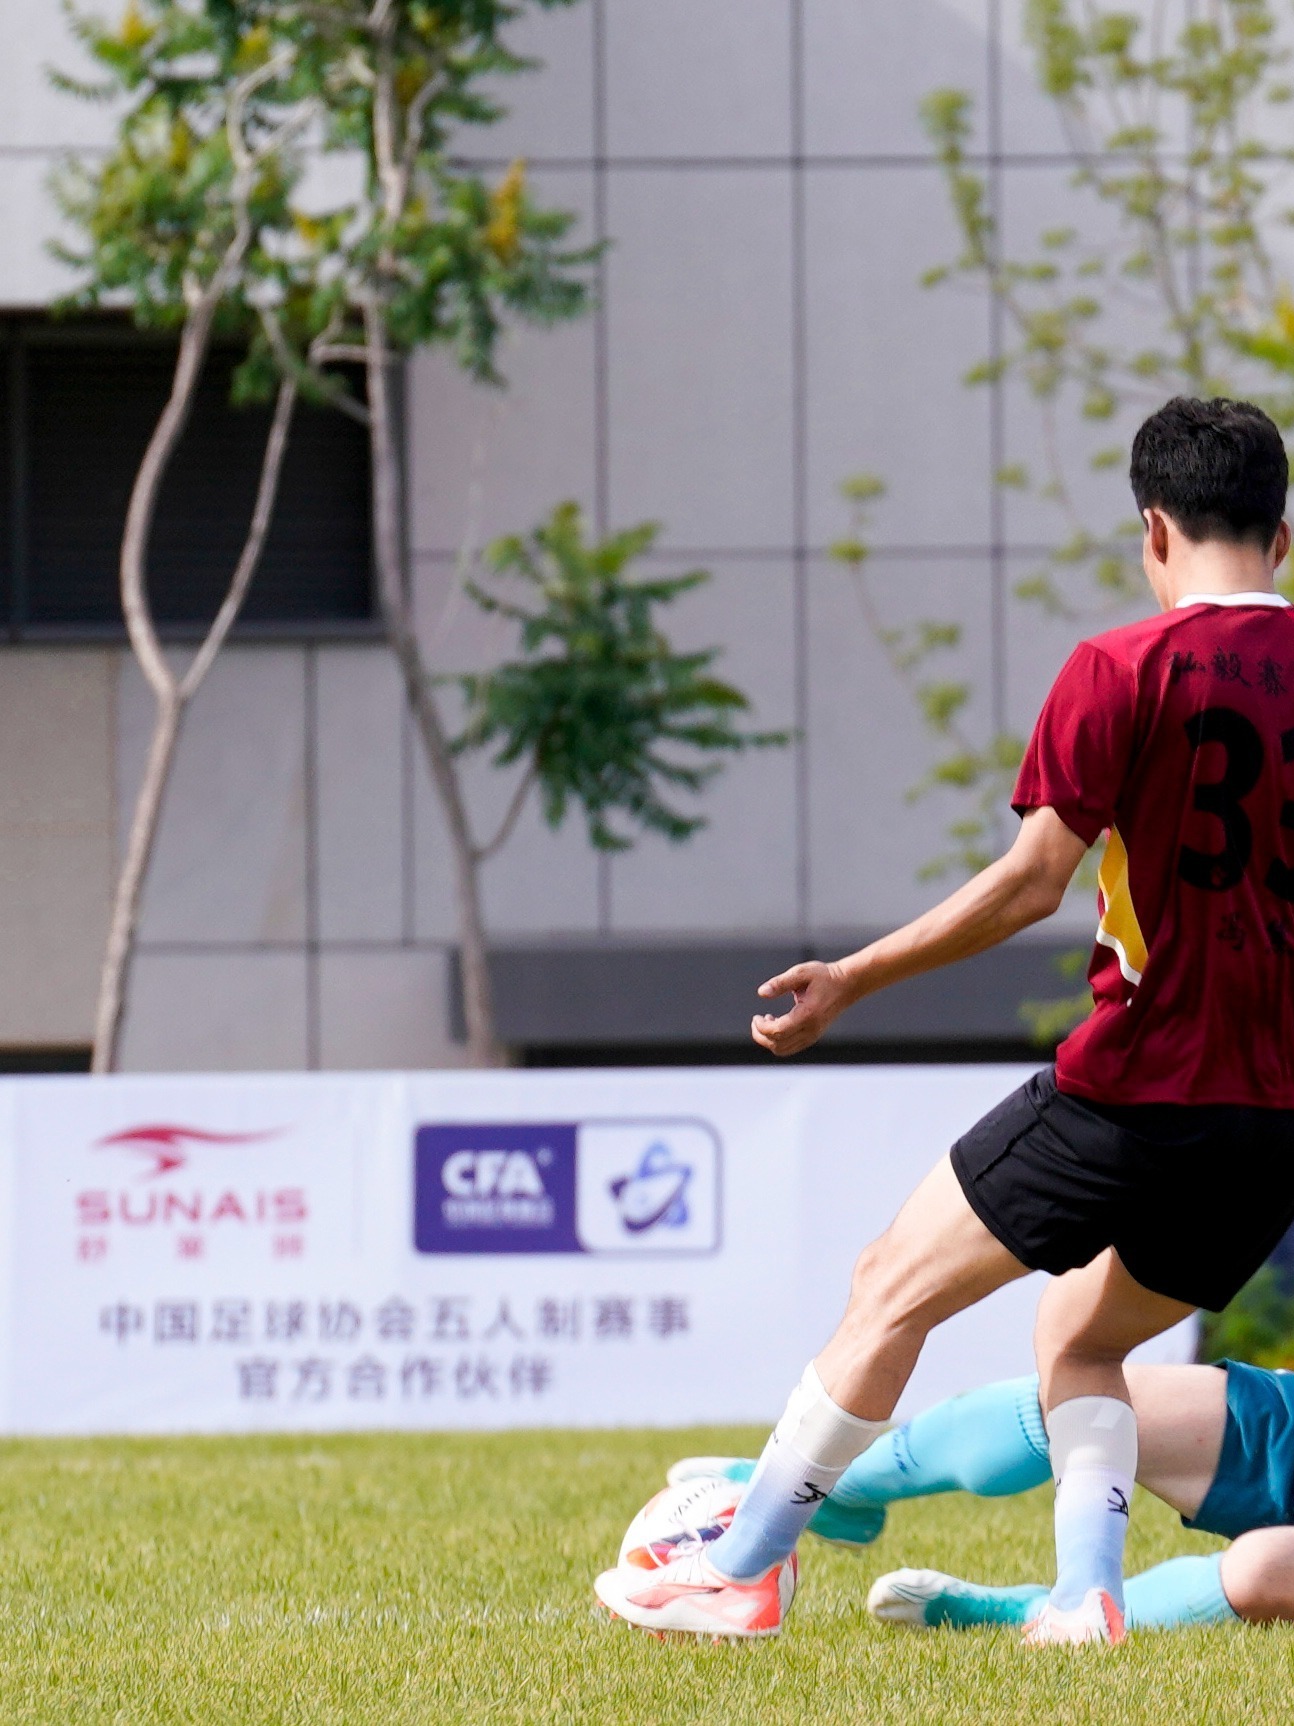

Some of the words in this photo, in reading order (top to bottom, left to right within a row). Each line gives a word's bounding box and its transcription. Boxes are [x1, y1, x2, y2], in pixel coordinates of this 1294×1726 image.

[441, 1149, 546, 1198] CFA
[76, 1188, 309, 1226] SUNAIS
[98, 1293, 690, 1345] 中国足球协会五人制赛事
[236, 1355, 555, 1402] 官方合作伙伴
